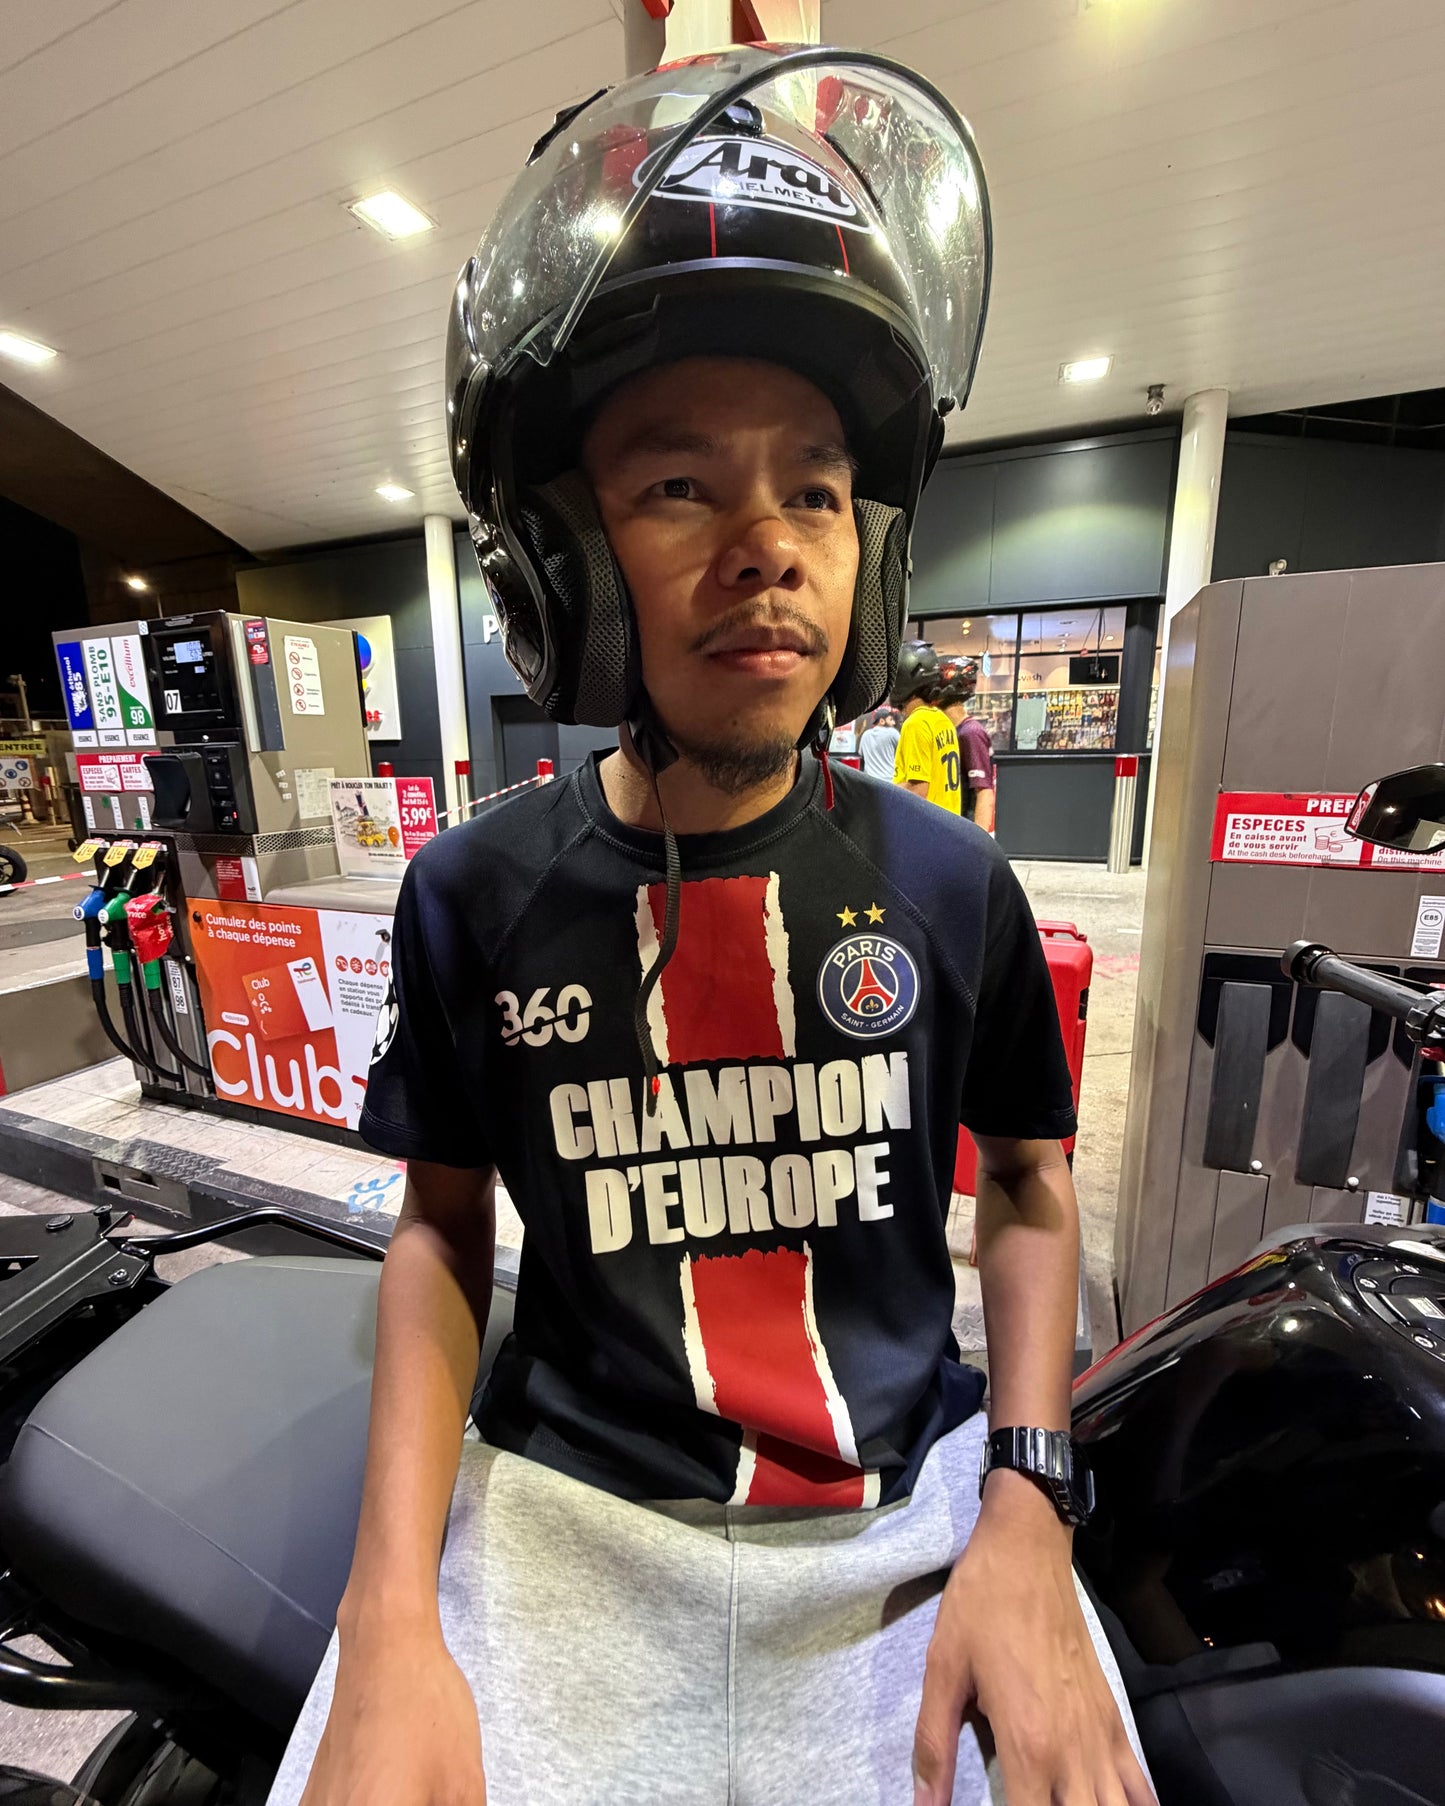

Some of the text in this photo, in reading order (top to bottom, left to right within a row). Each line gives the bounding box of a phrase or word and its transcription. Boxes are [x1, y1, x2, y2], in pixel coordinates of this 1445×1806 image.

[659, 142, 850, 208] Arai
[124, 639, 137, 688] excellium
[89, 646, 107, 723] SANS PLOMB
[166, 693, 180, 711] 07
[130, 709, 146, 725] 98
[401, 807, 433, 828] 5,99€
[1231, 817, 1306, 832] ESPECES
[1228, 841, 1299, 852] de vous servir
[1229, 831, 1307, 843] En caisse avant
[1238, 850, 1249, 858] the
[1271, 851, 1287, 860] desk
[1288, 852, 1332, 862] beforehand
[205, 913, 302, 935] Cumulez des points
[207, 926, 296, 948] à chaque dépense
[832, 940, 897, 969] PARIS
[250, 977, 271, 990] Club
[338, 978, 359, 987] Chaque
[494, 983, 593, 1049] 360
[207, 1029, 348, 1121] Club
[549, 1051, 912, 1161] CHAMPION
[585, 1141, 895, 1255] D'EUROPE
